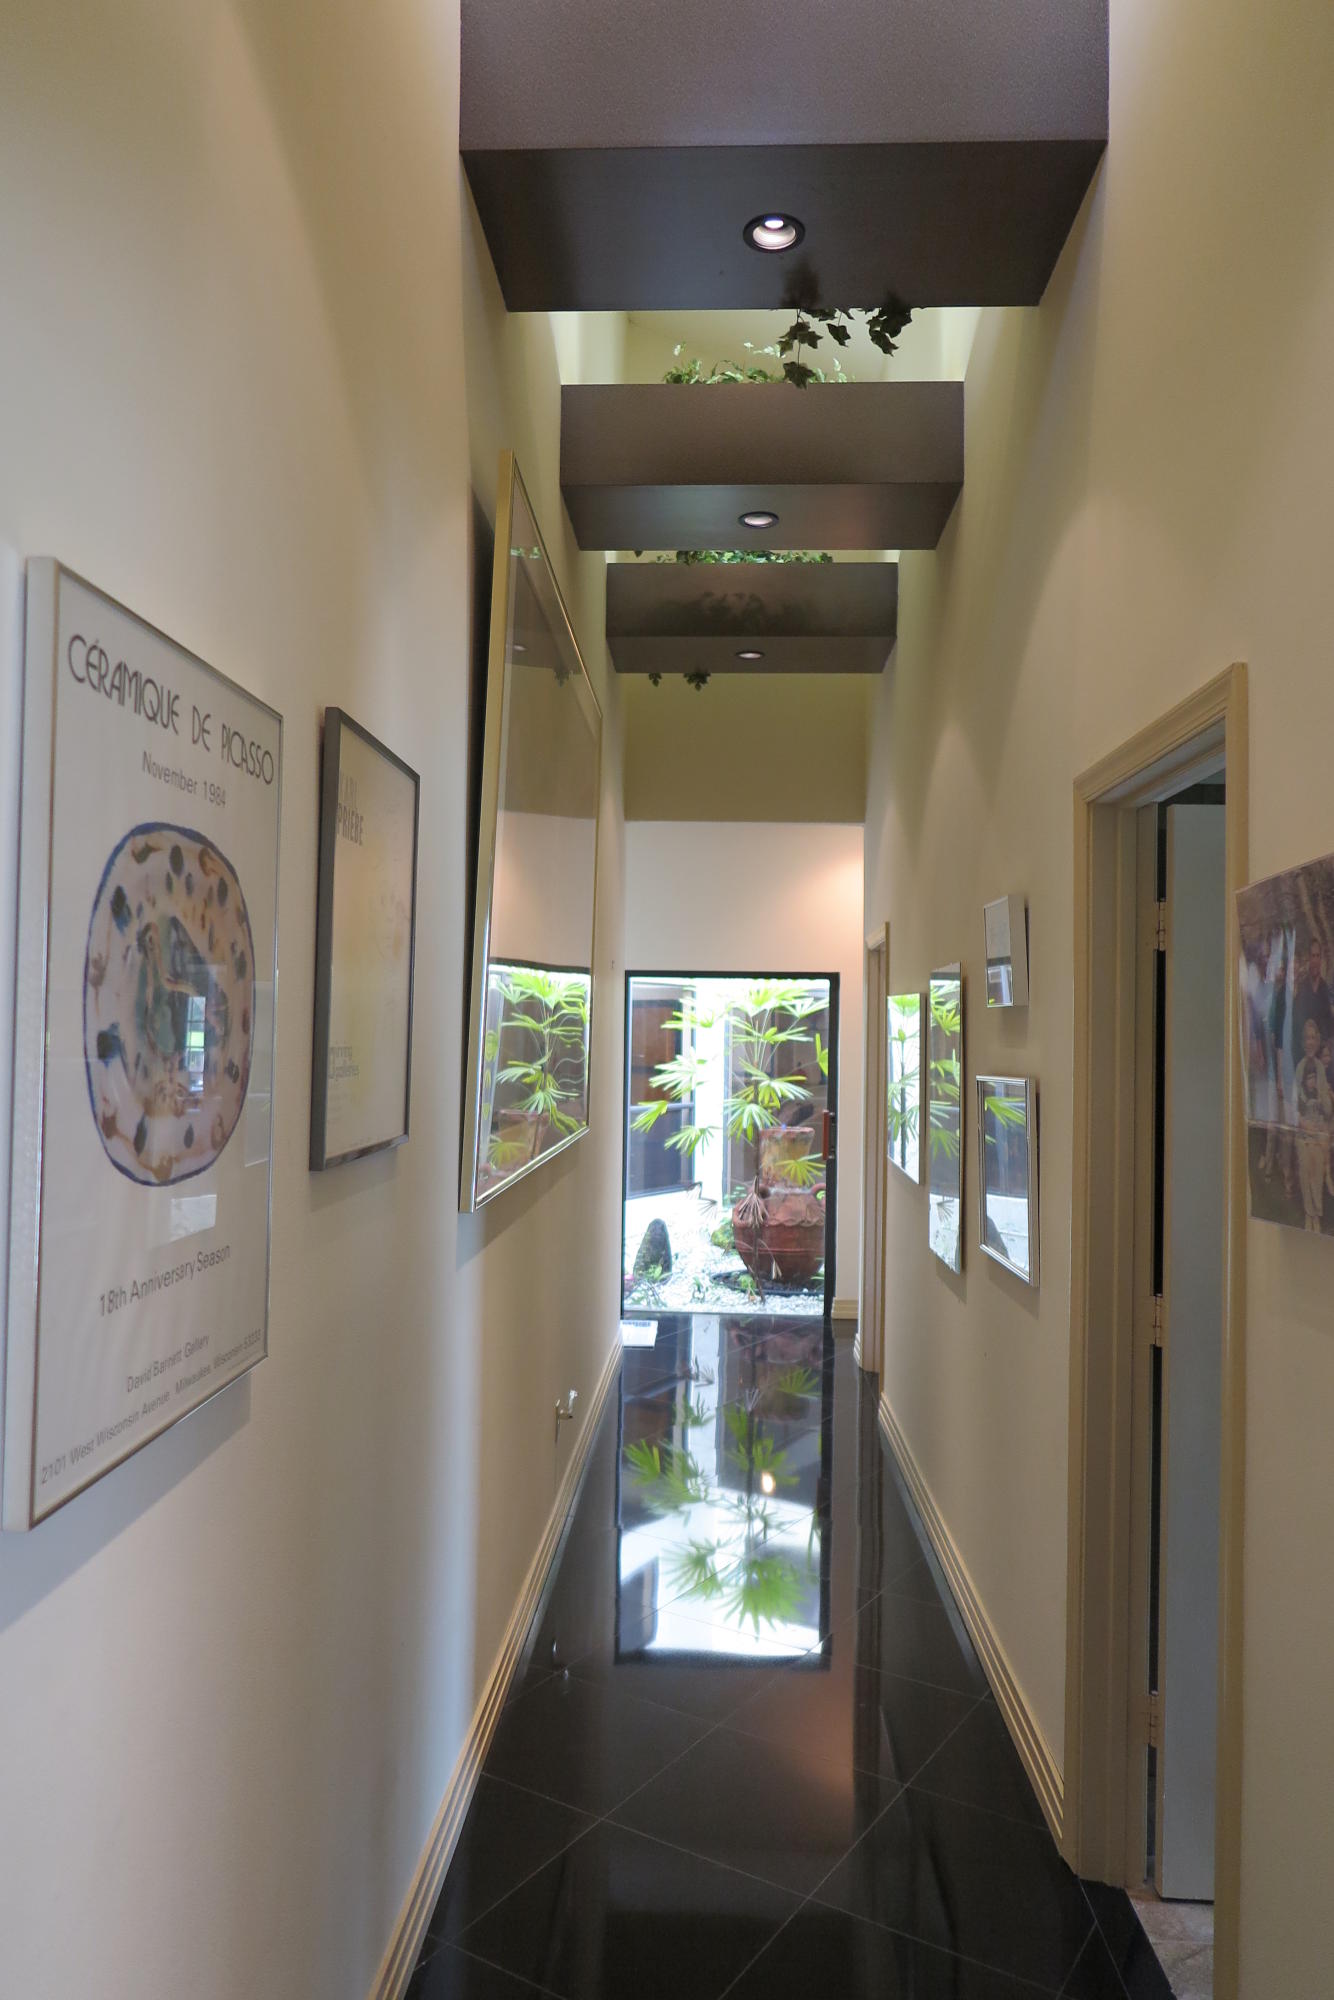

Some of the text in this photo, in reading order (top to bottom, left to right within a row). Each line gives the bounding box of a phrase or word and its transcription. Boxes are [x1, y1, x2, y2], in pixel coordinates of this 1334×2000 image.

[68, 634, 275, 786] CÉRAMIQUE DE PICASSO
[142, 750, 227, 808] November 1984
[99, 1244, 231, 1317] 18th Anniversary Season
[126, 1364, 152, 1393] David
[184, 1335, 210, 1358] Gallery
[41, 1454, 66, 1485] 2101
[69, 1438, 95, 1465] West
[96, 1410, 140, 1447] Wisconsin
[140, 1390, 171, 1416] Avenue
